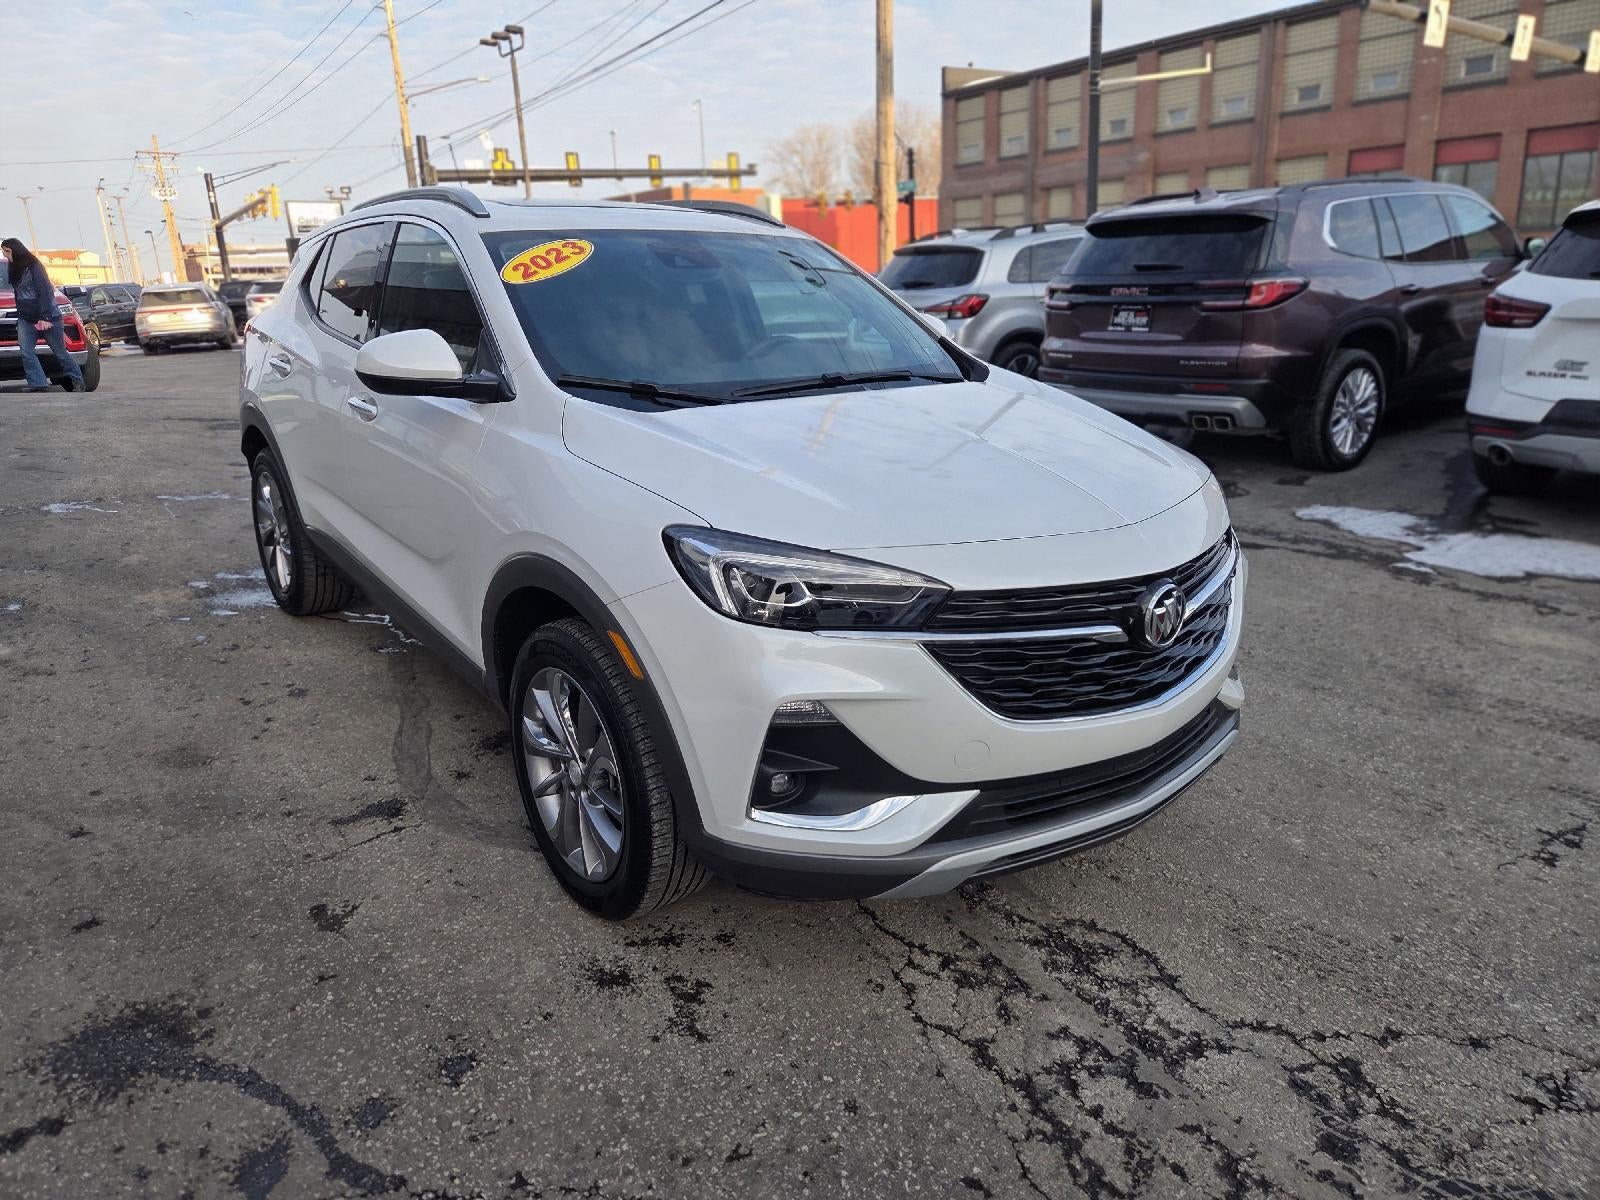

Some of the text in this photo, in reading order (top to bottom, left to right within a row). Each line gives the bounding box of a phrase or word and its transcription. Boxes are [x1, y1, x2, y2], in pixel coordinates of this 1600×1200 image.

[512, 241, 587, 281] 2023
[1111, 287, 1149, 296] GMC
[1525, 370, 1567, 379] BLAZER
